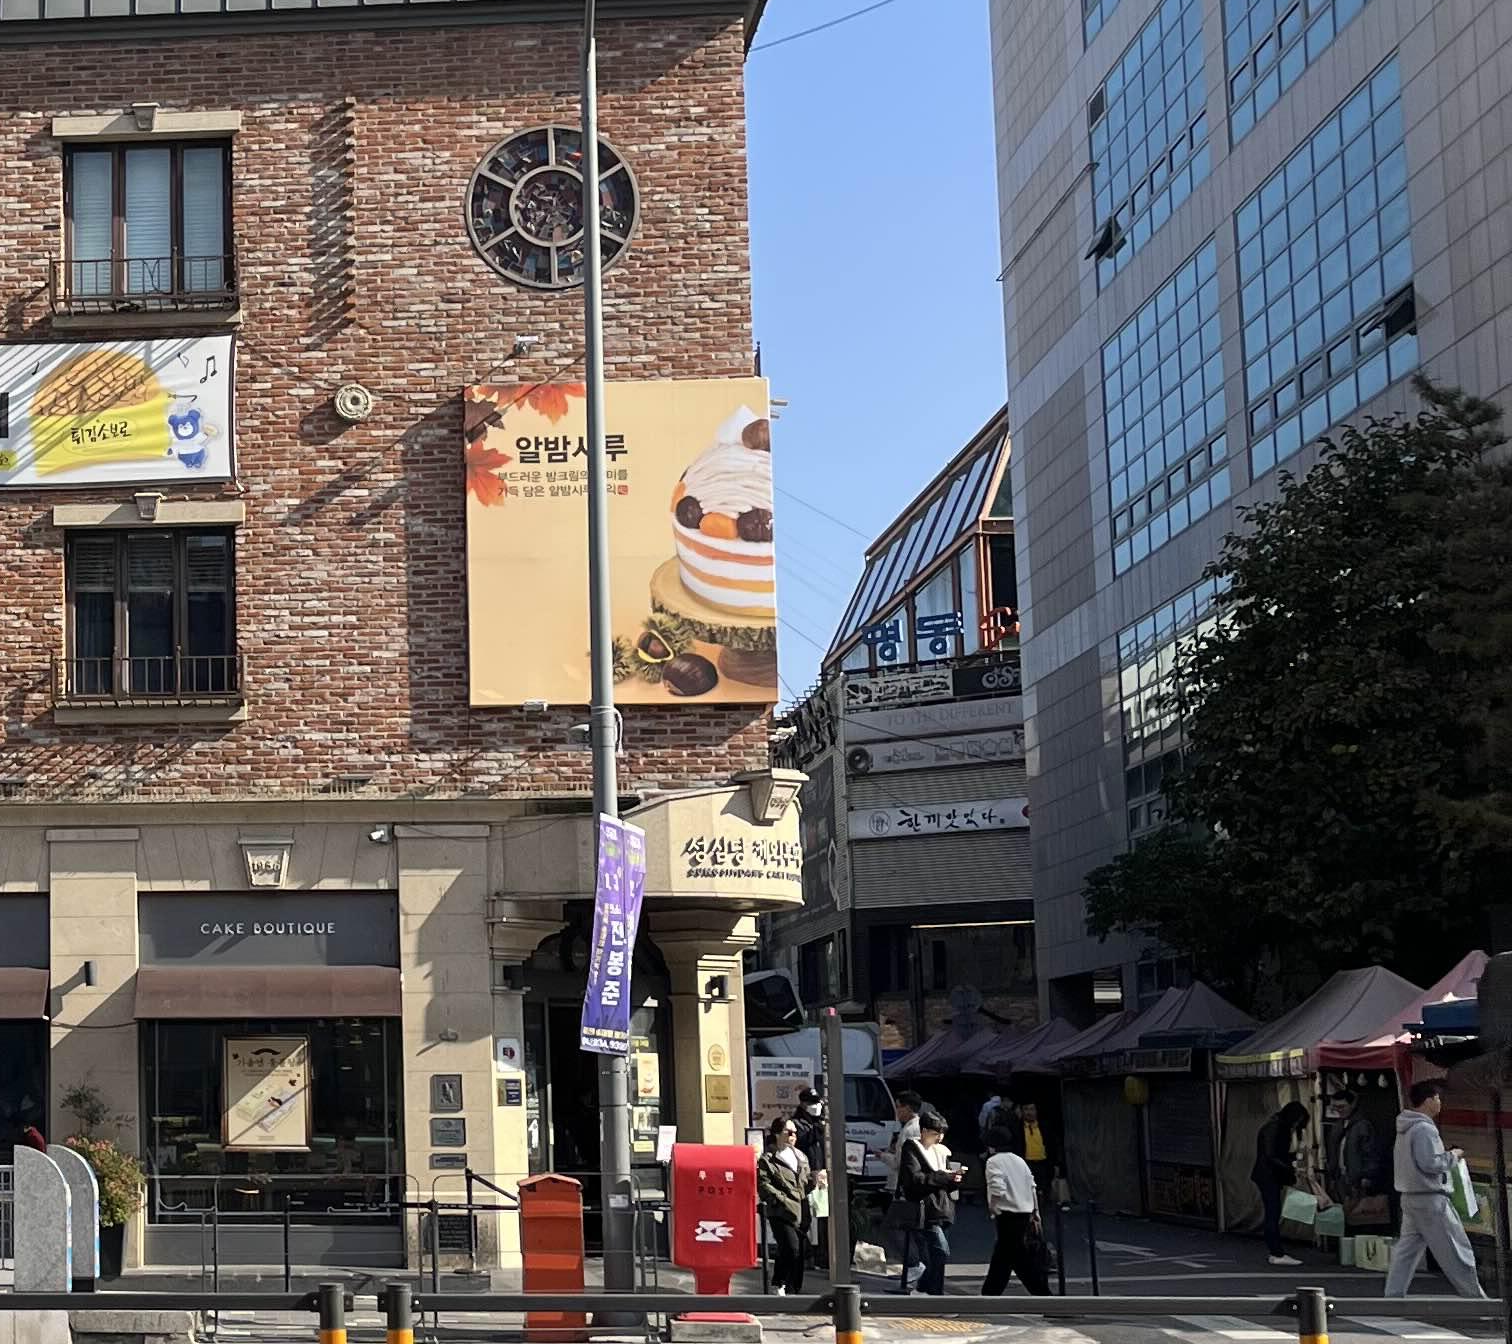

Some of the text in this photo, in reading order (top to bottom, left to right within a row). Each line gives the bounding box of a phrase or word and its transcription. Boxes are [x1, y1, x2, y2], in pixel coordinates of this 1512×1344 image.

[70, 420, 132, 445] 튀김소보로
[861, 612, 965, 662] 명동
[681, 836, 745, 867] 성심당
[199, 920, 337, 936] CAKE BOUTIQUE
